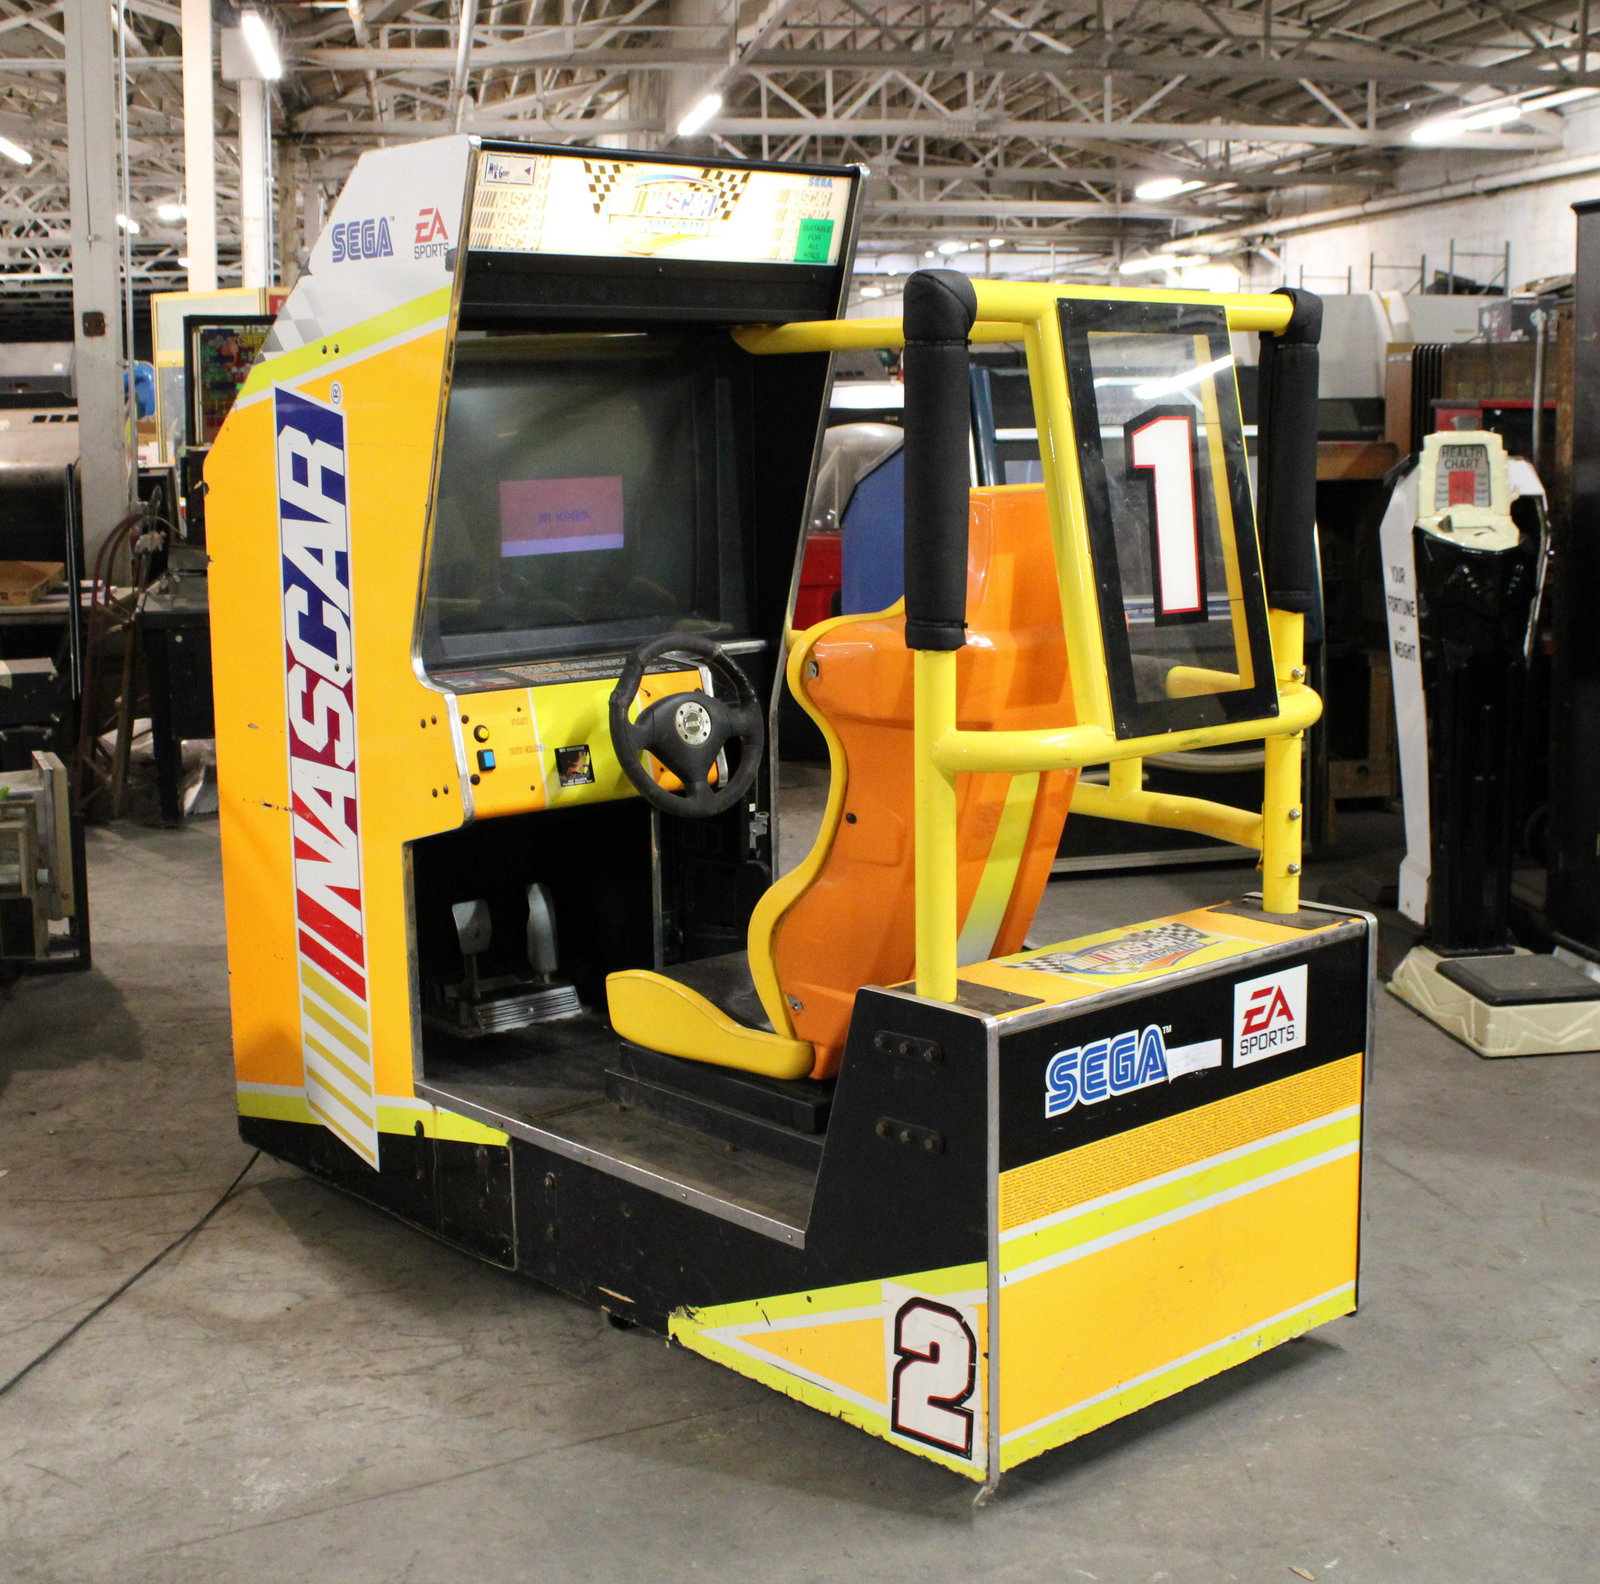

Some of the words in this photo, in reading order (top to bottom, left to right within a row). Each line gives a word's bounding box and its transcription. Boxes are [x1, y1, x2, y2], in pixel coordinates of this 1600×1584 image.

[332, 217, 394, 263] SEGA
[414, 207, 449, 244] EA
[414, 242, 449, 260] SPORTS
[1442, 447, 1483, 458] HEALTH
[1444, 459, 1479, 470] CHART
[1124, 405, 1208, 627] 1
[1388, 595, 1415, 617] FORTUNE
[1394, 640, 1416, 661] WEIGHT
[278, 424, 364, 938] NASCAR
[1241, 985, 1295, 1037] EA
[1240, 1024, 1295, 1056] SPORTS
[1045, 1024, 1168, 1118] SEGA
[891, 1297, 977, 1460] 2
